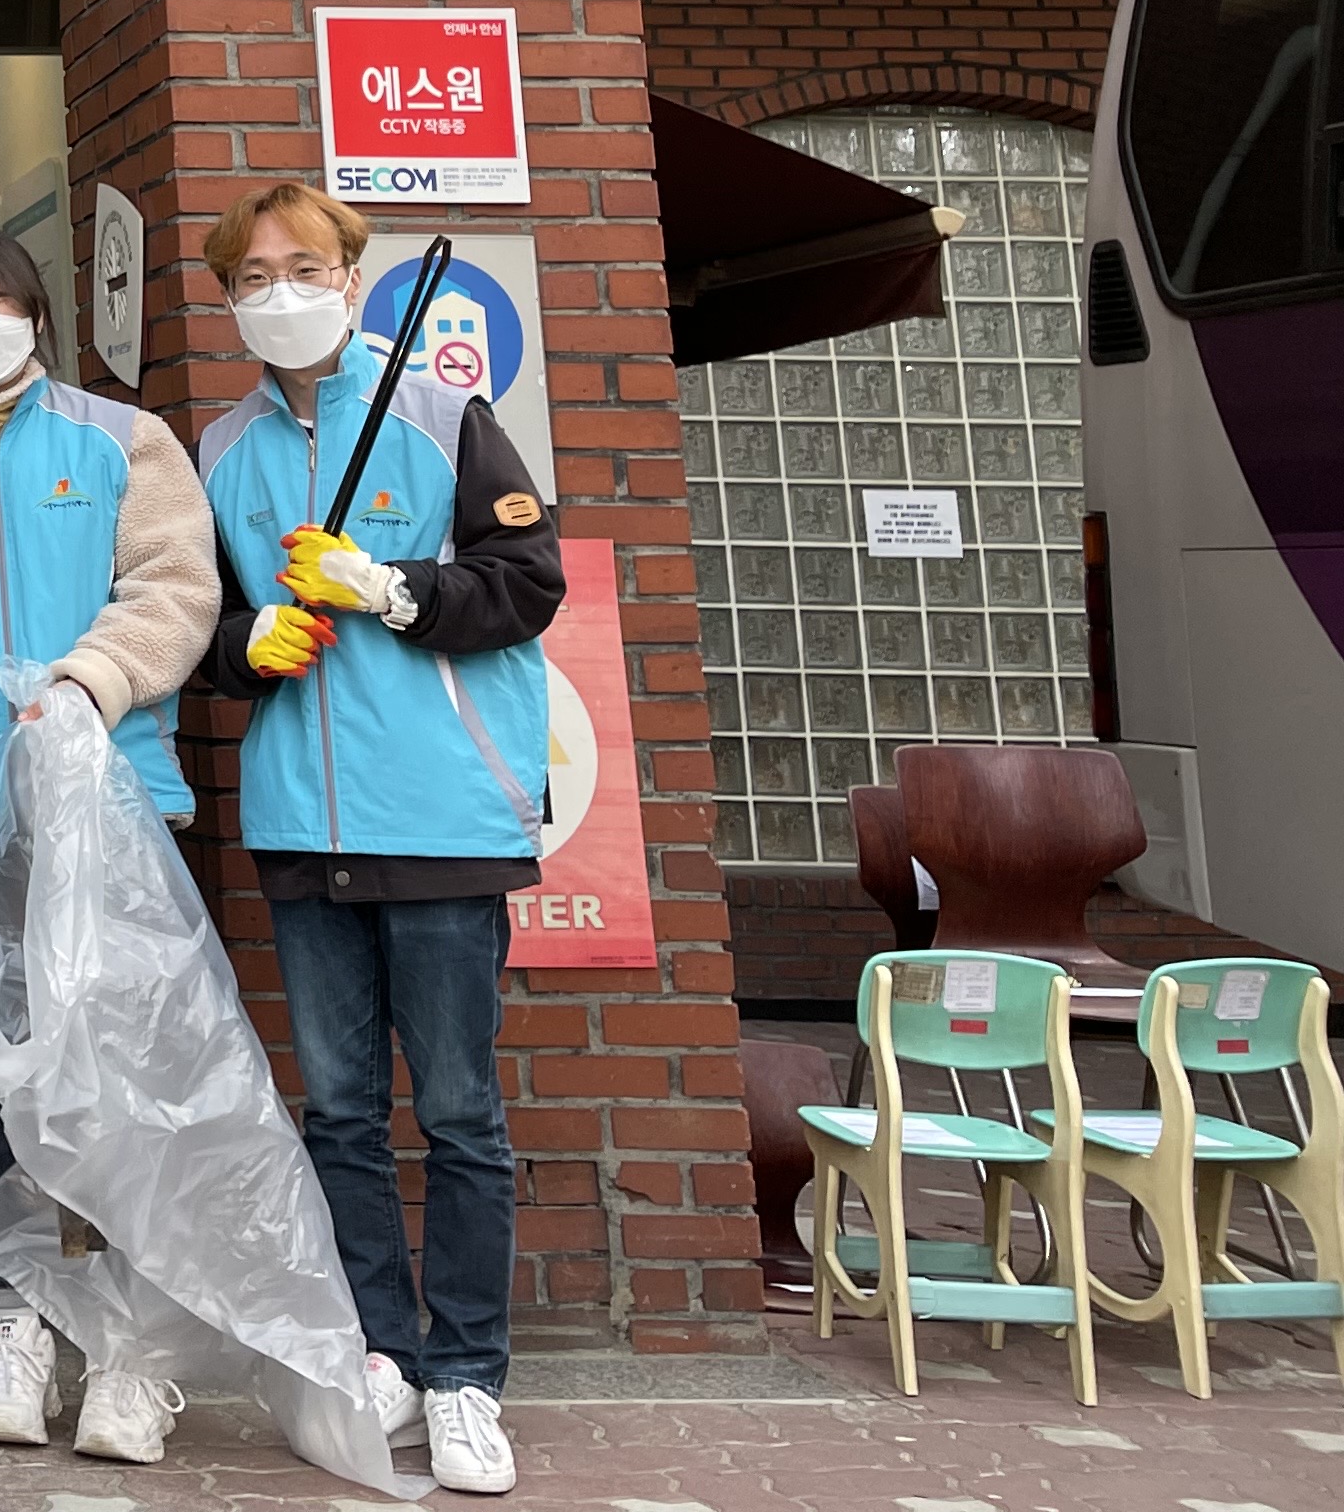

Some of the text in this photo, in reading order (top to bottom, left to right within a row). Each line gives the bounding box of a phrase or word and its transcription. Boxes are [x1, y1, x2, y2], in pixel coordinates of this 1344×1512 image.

[443, 23, 502, 36] 언제나 안심
[361, 66, 484, 112] 에스원
[380, 118, 466, 135] CCTV 작동중
[337, 167, 438, 193] SECOM
